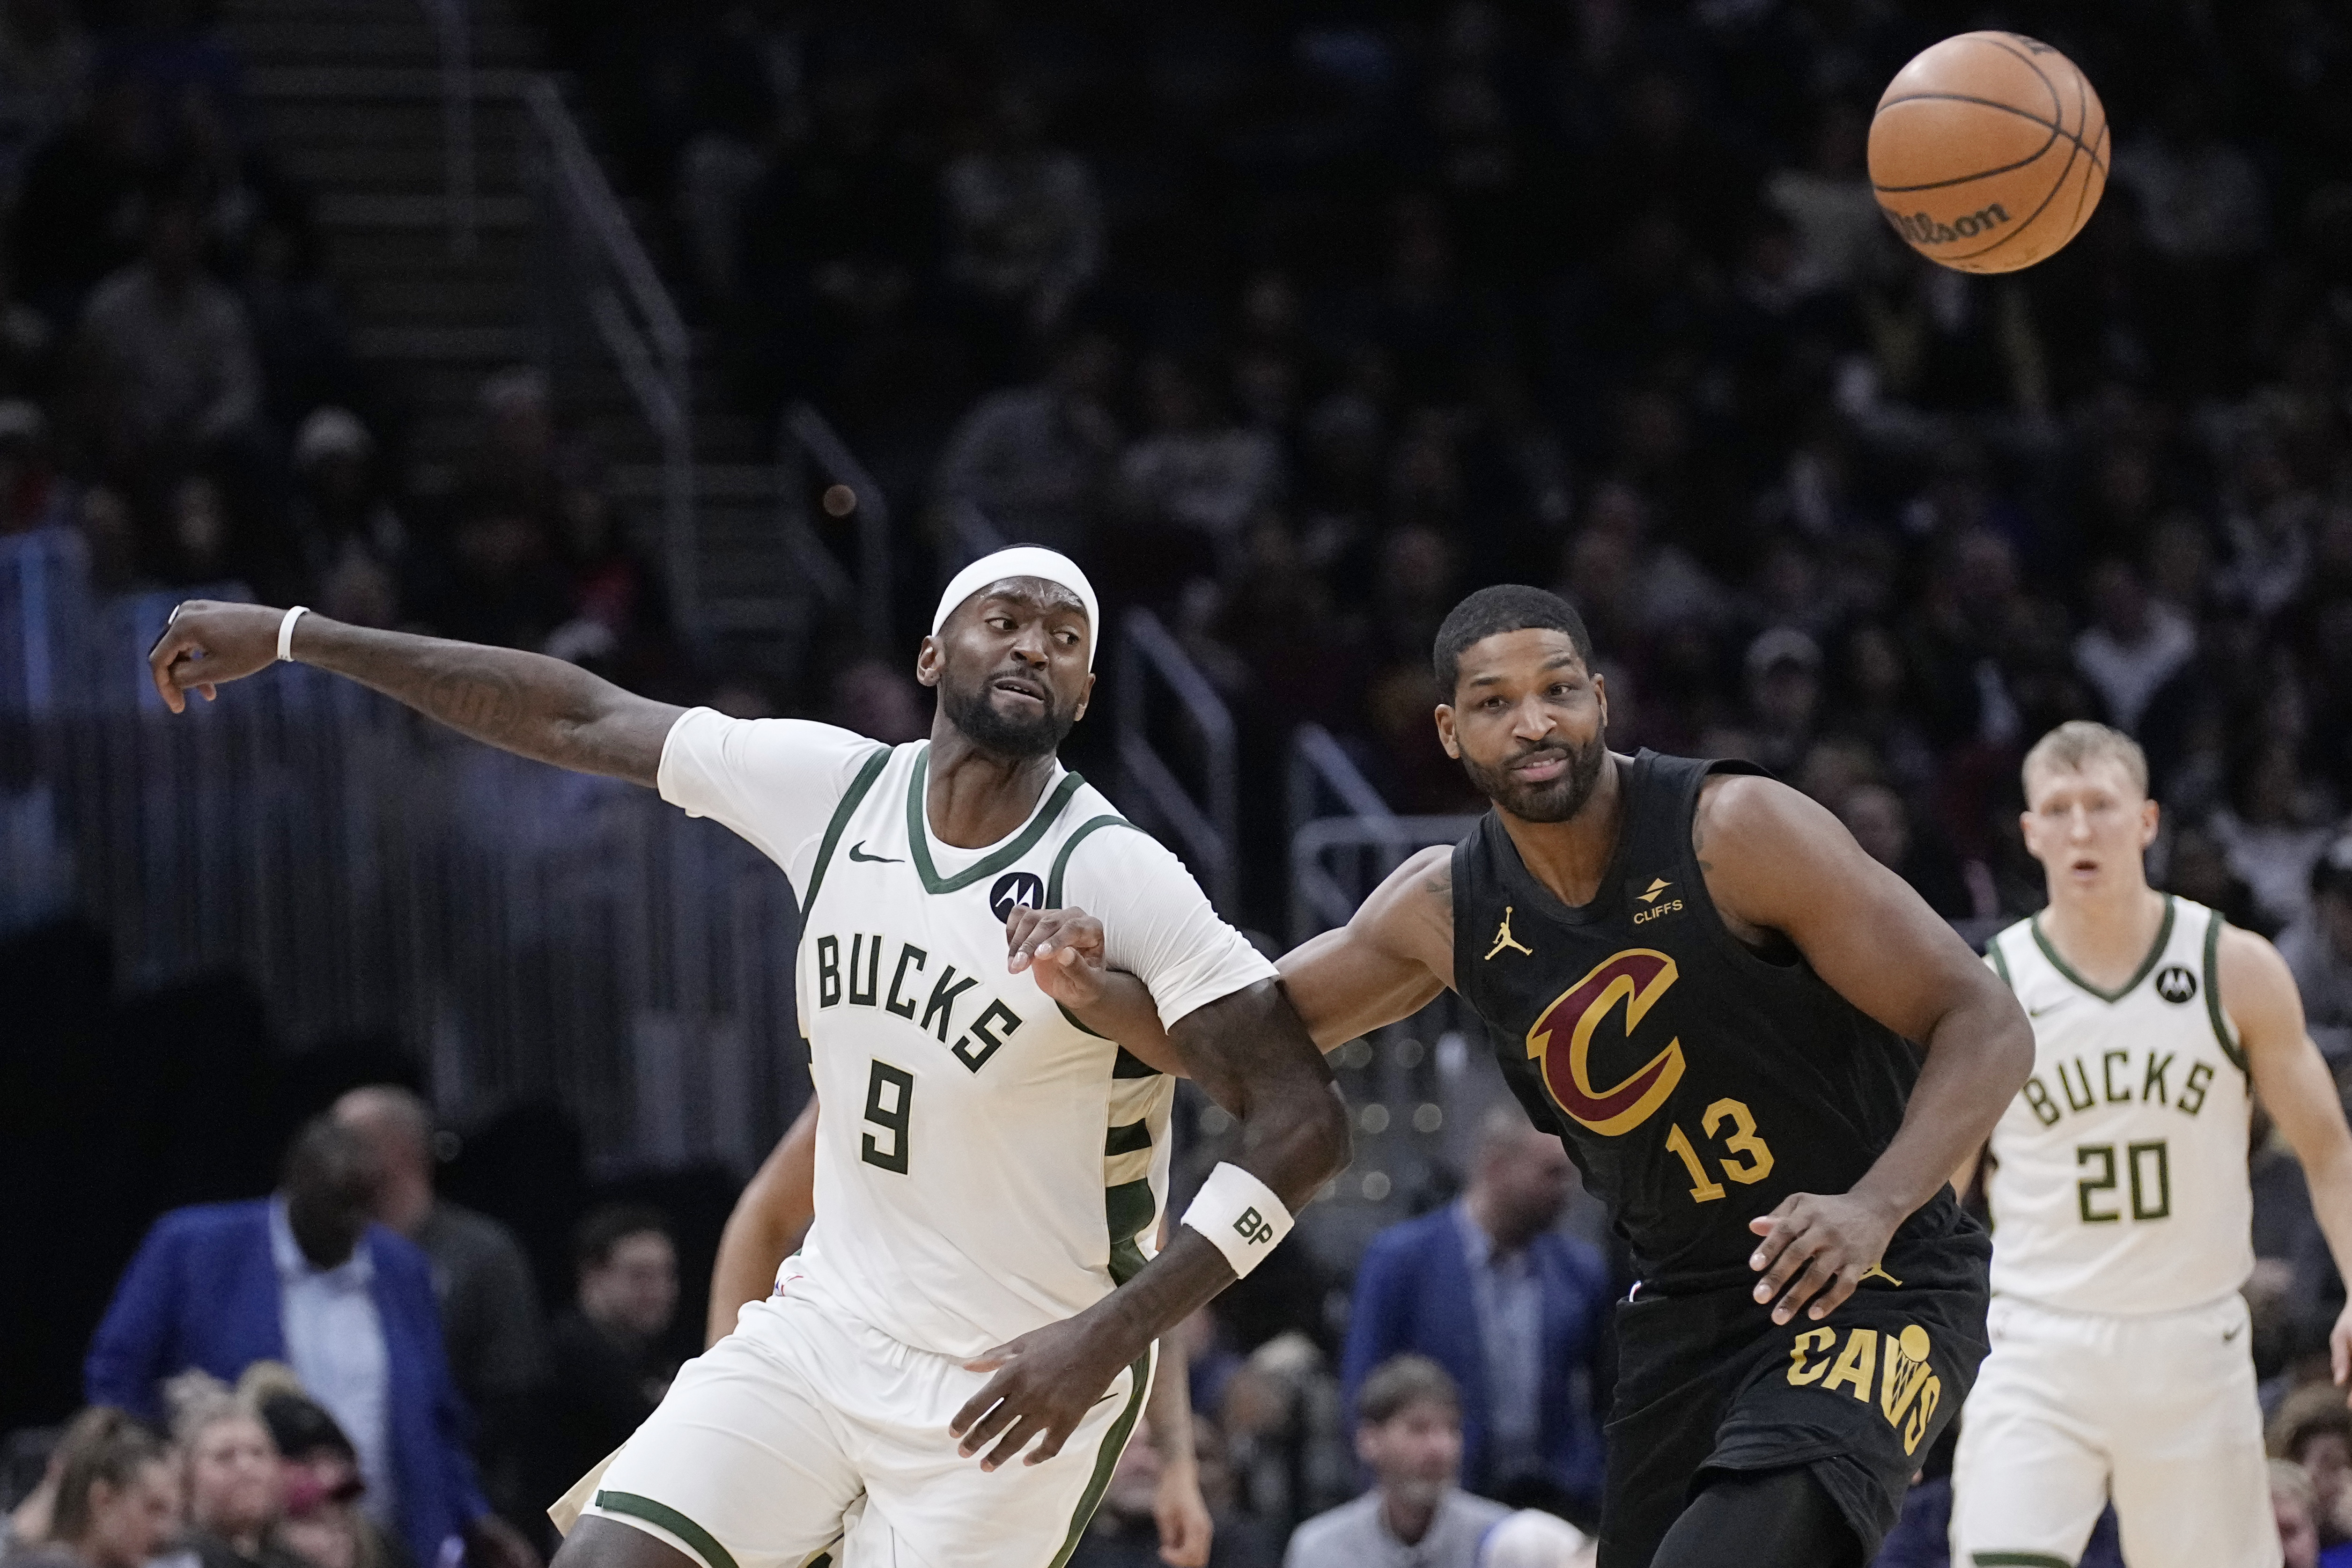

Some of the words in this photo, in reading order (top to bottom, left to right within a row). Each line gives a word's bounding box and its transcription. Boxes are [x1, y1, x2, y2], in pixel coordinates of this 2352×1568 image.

[1633, 899, 1683, 924] CLIFFS
[817, 932, 1025, 1075] BUCKS
[861, 1058, 915, 1176] 9
[2021, 1050, 2215, 1125] BUCKS
[1666, 1097, 1775, 1203] 13
[2076, 1140, 2170, 1222] 20
[1232, 1206, 1273, 1246] BP
[1786, 1325, 1941, 1457] CAVS
